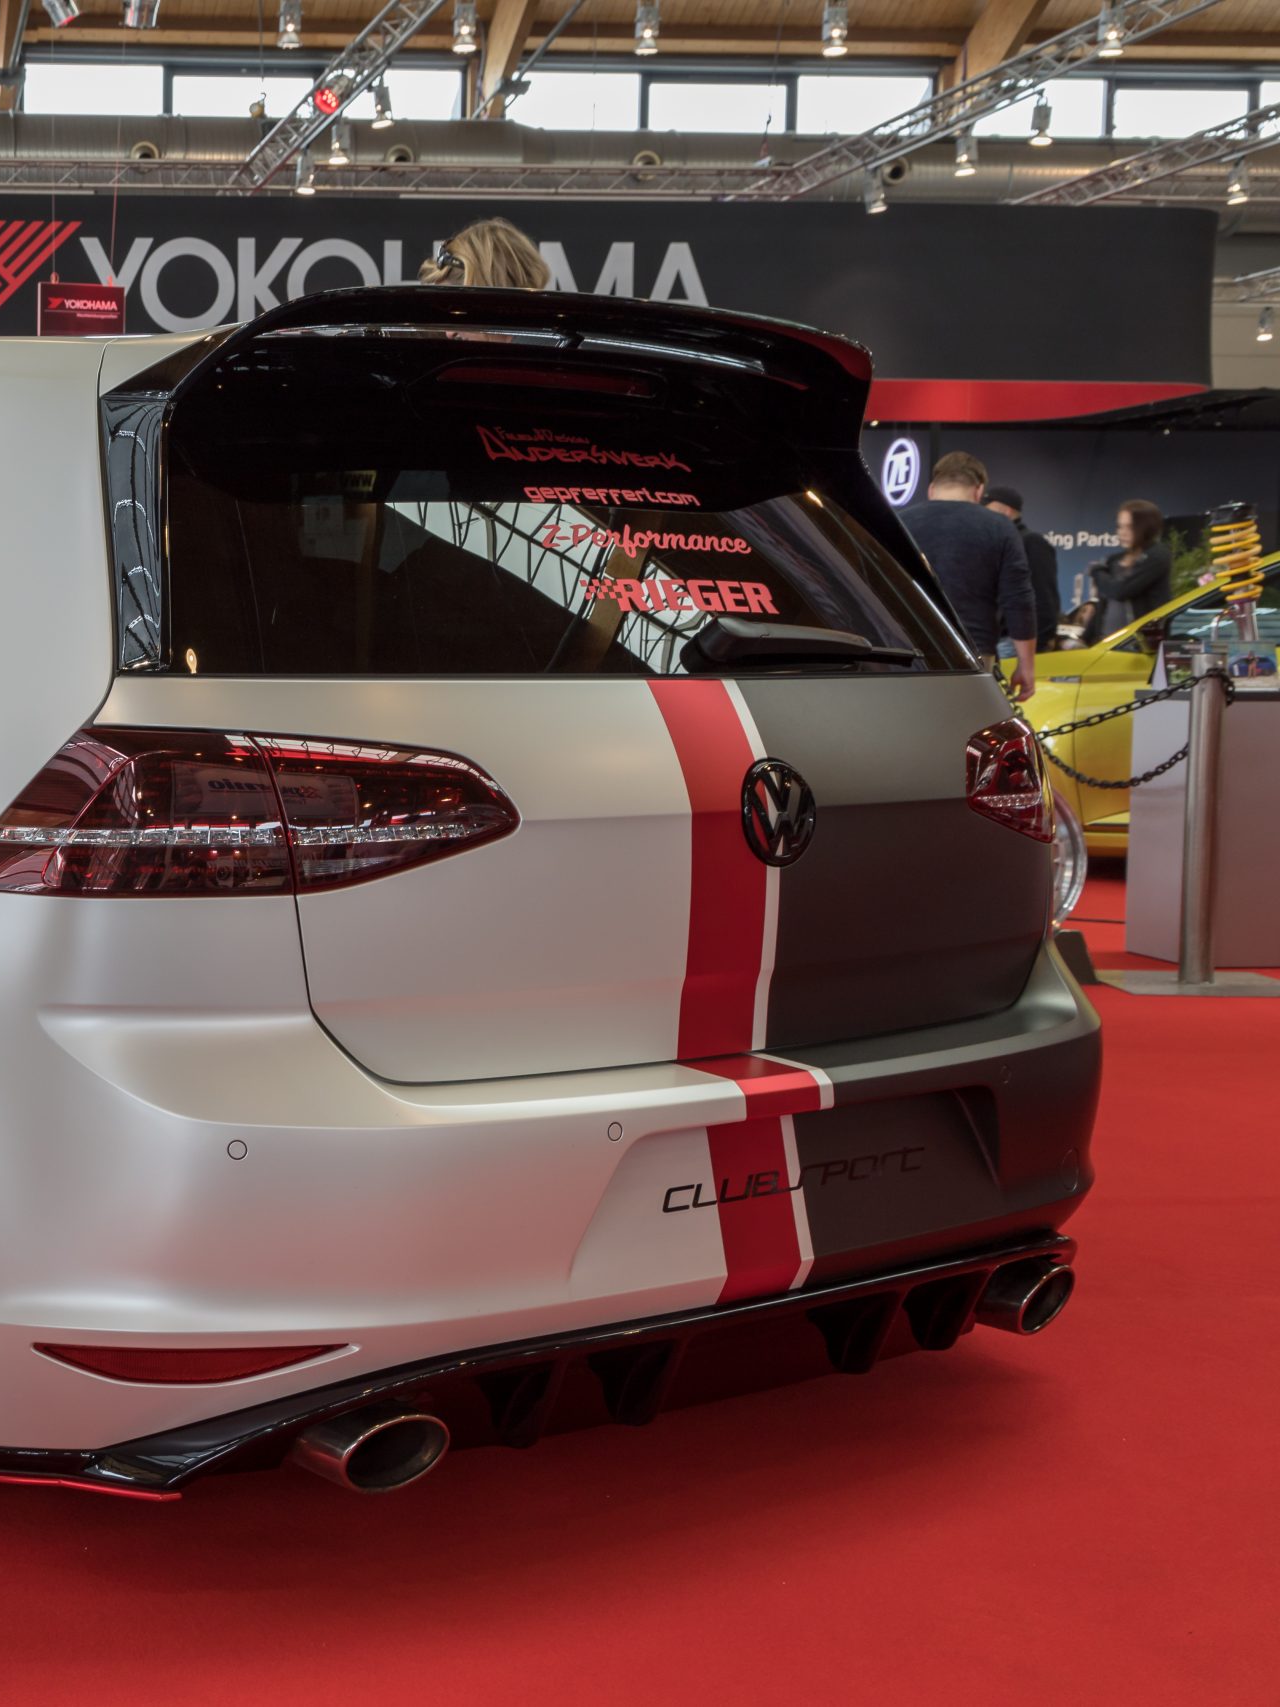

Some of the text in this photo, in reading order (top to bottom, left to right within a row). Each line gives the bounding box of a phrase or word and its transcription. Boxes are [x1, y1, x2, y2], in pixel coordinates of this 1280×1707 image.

[80, 236, 709, 332] YOKOHMA
[64, 299, 118, 311] YOKOHAMA
[523, 486, 702, 507] gepfeffert.com
[1076, 531, 1121, 547] Parts
[616, 578, 781, 615] RIEGER
[661, 1146, 927, 1214] CLUBSPORT
